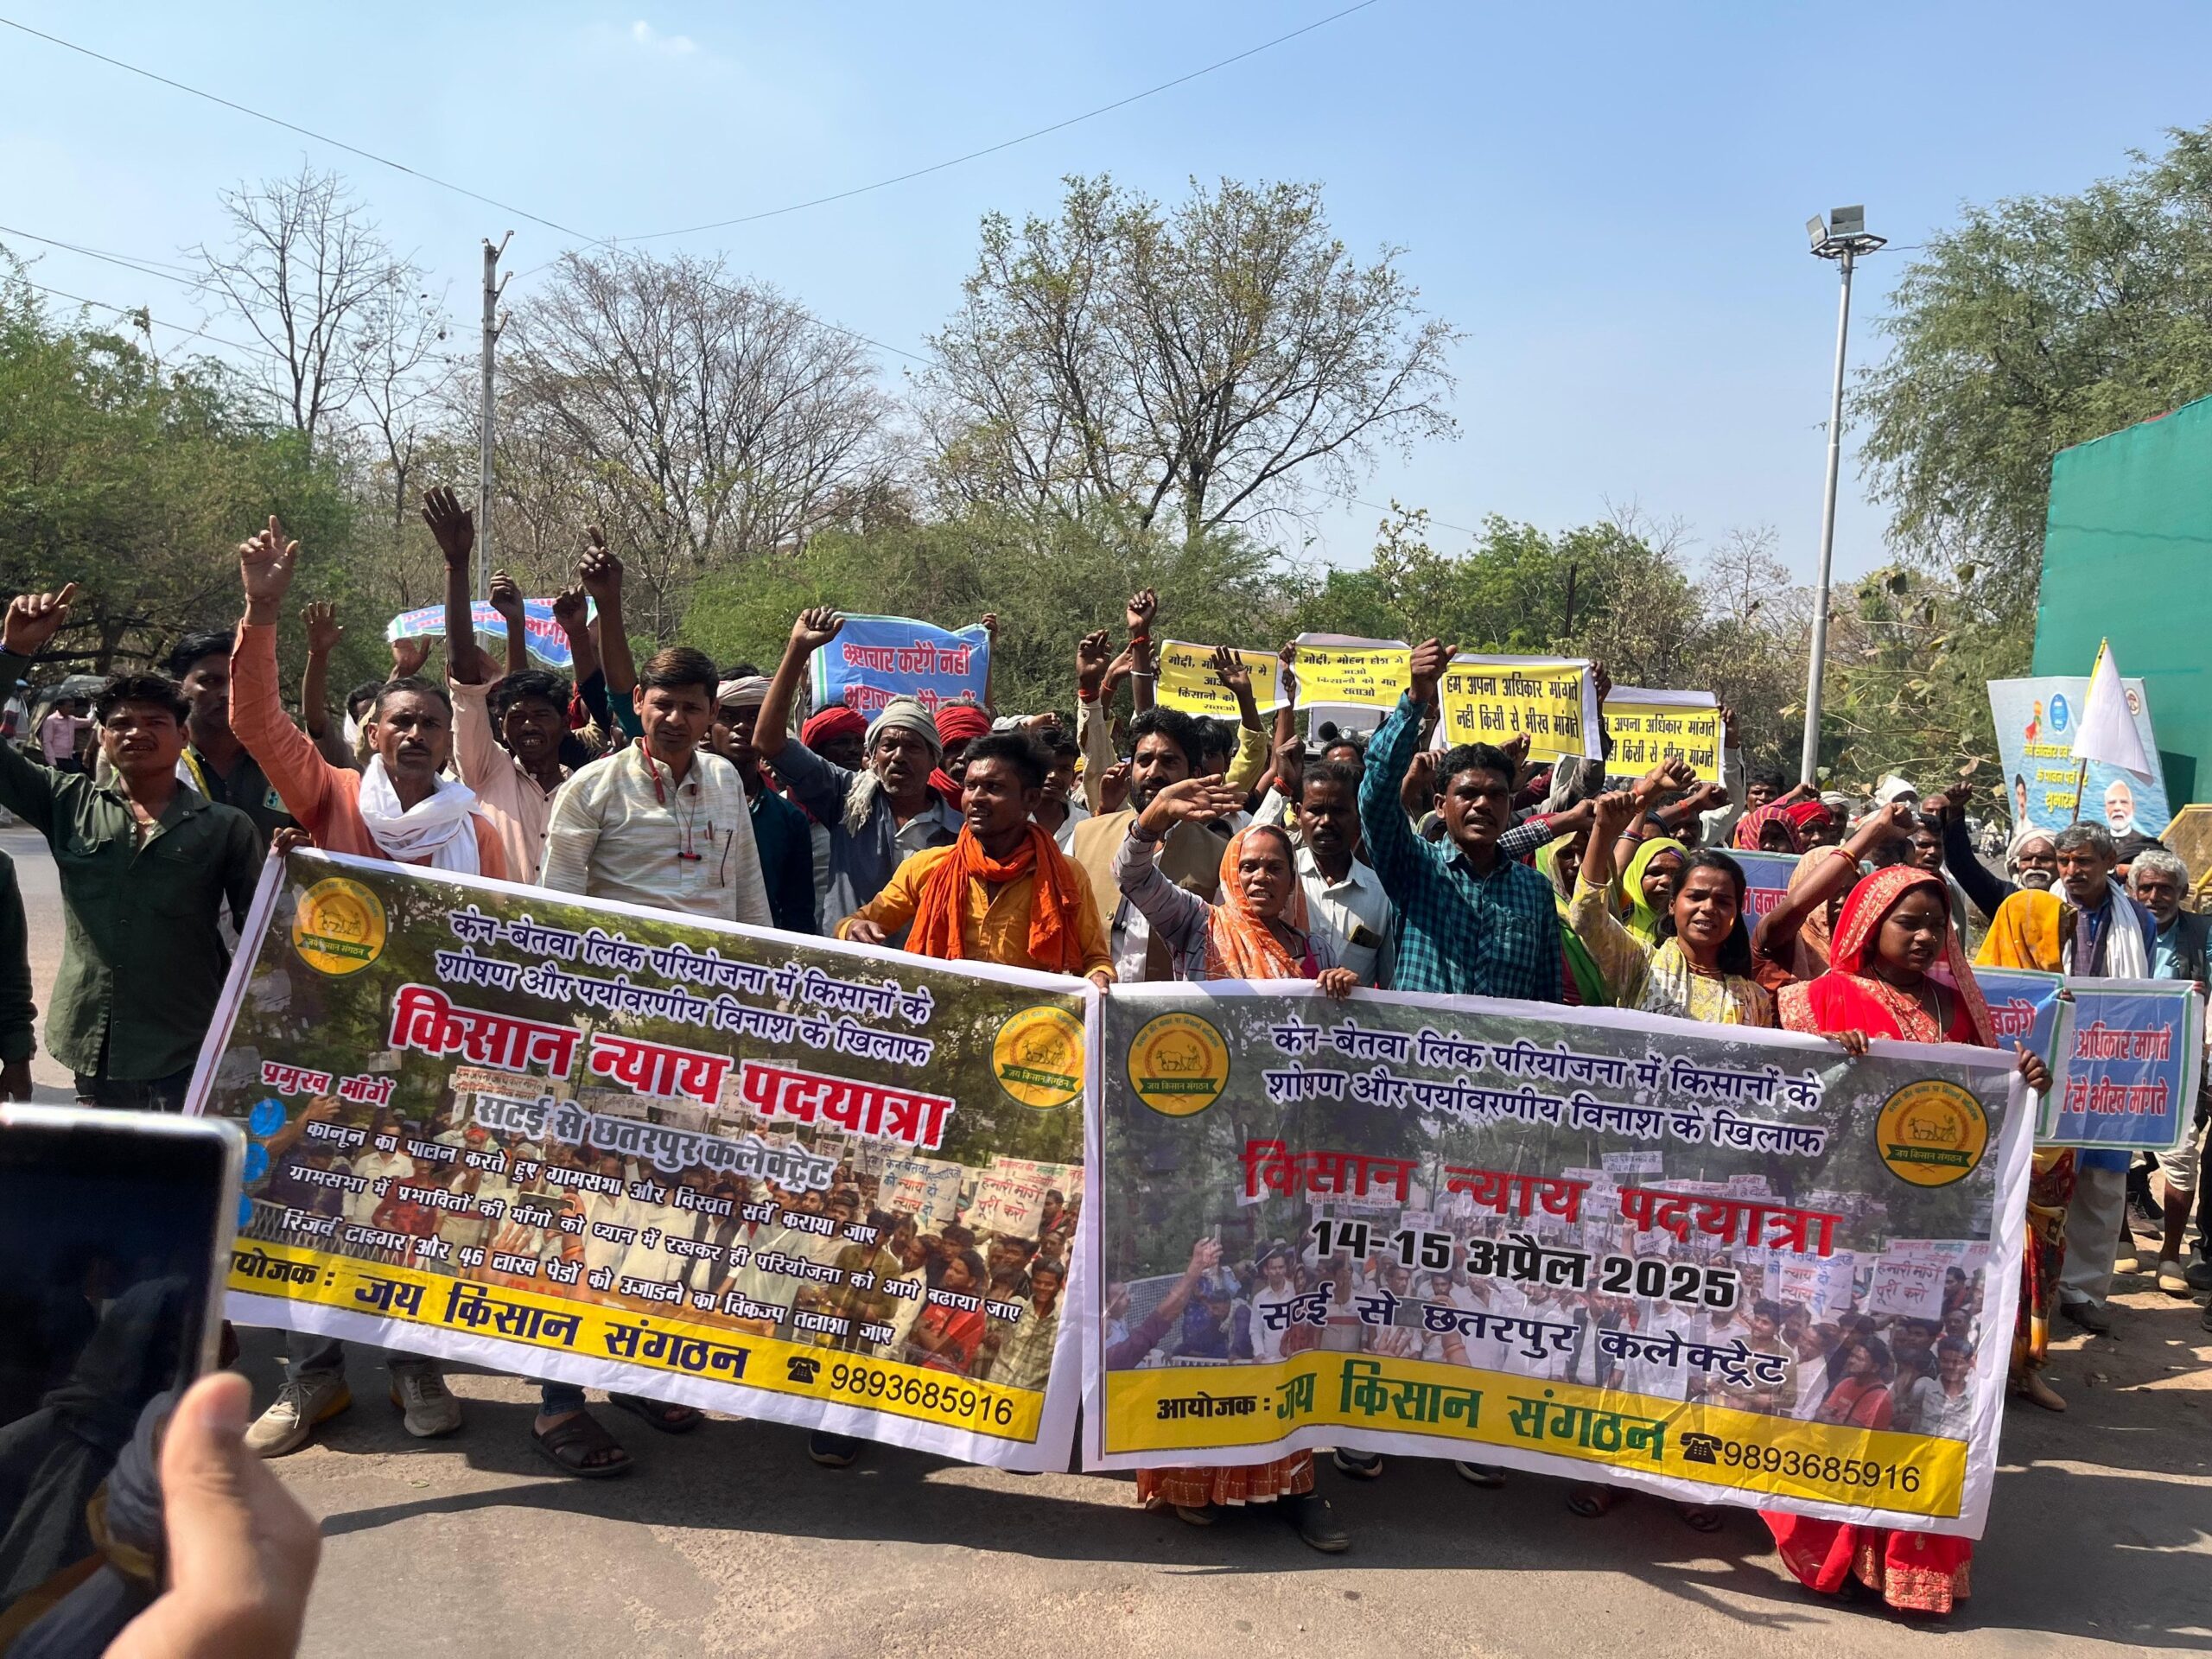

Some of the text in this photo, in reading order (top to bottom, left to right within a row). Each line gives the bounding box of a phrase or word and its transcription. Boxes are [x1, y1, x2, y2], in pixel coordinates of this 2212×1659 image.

[1447, 671, 1579, 702] हम अपना अधिकार मांगते
[1479, 704, 1504, 731] किसी
[1510, 704, 1519, 732] से
[1526, 707, 1548, 734] भीख
[1553, 709, 1580, 739] मांगते
[1614, 714, 1715, 738] अपना अधिकार मांगते
[1623, 740, 1644, 762] किसी
[1649, 741, 1657, 762] से
[1689, 745, 1713, 768] मांगते
[438, 949, 933, 1065] शोषण और पर्यावरणीय विनाश के खिलाफ
[451, 907, 931, 1023] केन-बेतवा लिंक परियोजना में किसानों के
[262, 1062, 332, 1096] प्रमुख
[393, 987, 581, 1077] किसान
[591, 1035, 731, 1103] न्याय
[741, 1063, 952, 1147] पदयात्रा
[1272, 1017, 1821, 1109] केन-बेतवा लिंक परियोजना में किसानों के
[2076, 1020, 2132, 1060] अधिकार
[2133, 1022, 2172, 1062] मांगते
[556, 1102, 588, 1141] से
[593, 1118, 703, 1172] छतरपुर
[1265, 1064, 1827, 1156] शोषण और पर्यावरणीय विनाश के खिलाफ
[2072, 1075, 2089, 1114] से
[2089, 1075, 2128, 1114] भीख
[2129, 1077, 2169, 1116] मांगते
[308, 1121, 365, 1149] कानून
[374, 1133, 397, 1154] का
[407, 1141, 457, 1164] पालन
[465, 1149, 510, 1174] करते
[515, 1160, 537, 1184] हुए
[546, 1165, 623, 1196] ग्रामसभा
[630, 1179, 666, 1204] और
[782, 1211, 836, 1236] कराया
[843, 1222, 879, 1244] जाए
[899, 1177, 926, 1194] न्याय
[1238, 1139, 1419, 1202] किसान
[1445, 1166, 1592, 1224] न्याय
[1617, 1184, 1844, 1258] पदयात्रा
[282, 1208, 344, 1237] रिजर्व
[345, 1224, 409, 1252] टाइगर
[414, 1235, 452, 1260] और
[492, 1255, 538, 1278] लाख
[588, 1267, 613, 1292] को
[691, 1290, 715, 1312] का
[792, 1309, 851, 1336] तलाशा
[858, 1321, 895, 1346] जाए
[289, 1164, 367, 1194] ग्रामसभा
[373, 1177, 393, 1198] में
[397, 1185, 476, 1214] प्रभावितों
[480, 1198, 505, 1220] की
[560, 1213, 587, 1236] को
[593, 1223, 637, 1245] ध्यान
[641, 1228, 661, 1249] में
[665, 1236, 723, 1262] रखकर
[729, 1247, 750, 1267] ही
[756, 1251, 844, 1286] परियोजना
[849, 1271, 876, 1291] को
[882, 1277, 923, 1300] आगे
[985, 1299, 1023, 1323] जाए
[1312, 1219, 1453, 1271] 14-15
[1466, 1233, 1591, 1288] अप्रैल
[1603, 1256, 1738, 1307] 2025
[1784, 1268, 1815, 1282] न्याय
[355, 1272, 426, 1318] जय
[443, 1281, 583, 1346] किसान
[603, 1319, 752, 1380] संगठन
[830, 1363, 1014, 1425] 9893685916
[1260, 1281, 1333, 1331] सटई
[1355, 1290, 1400, 1326] से
[1422, 1304, 1581, 1358] छतरपुर
[1276, 1372, 1318, 1421] जय
[1339, 1358, 1484, 1429] किसान
[1506, 1389, 1668, 1462] संगठन
[1723, 1441, 1922, 1493] 9893685916
